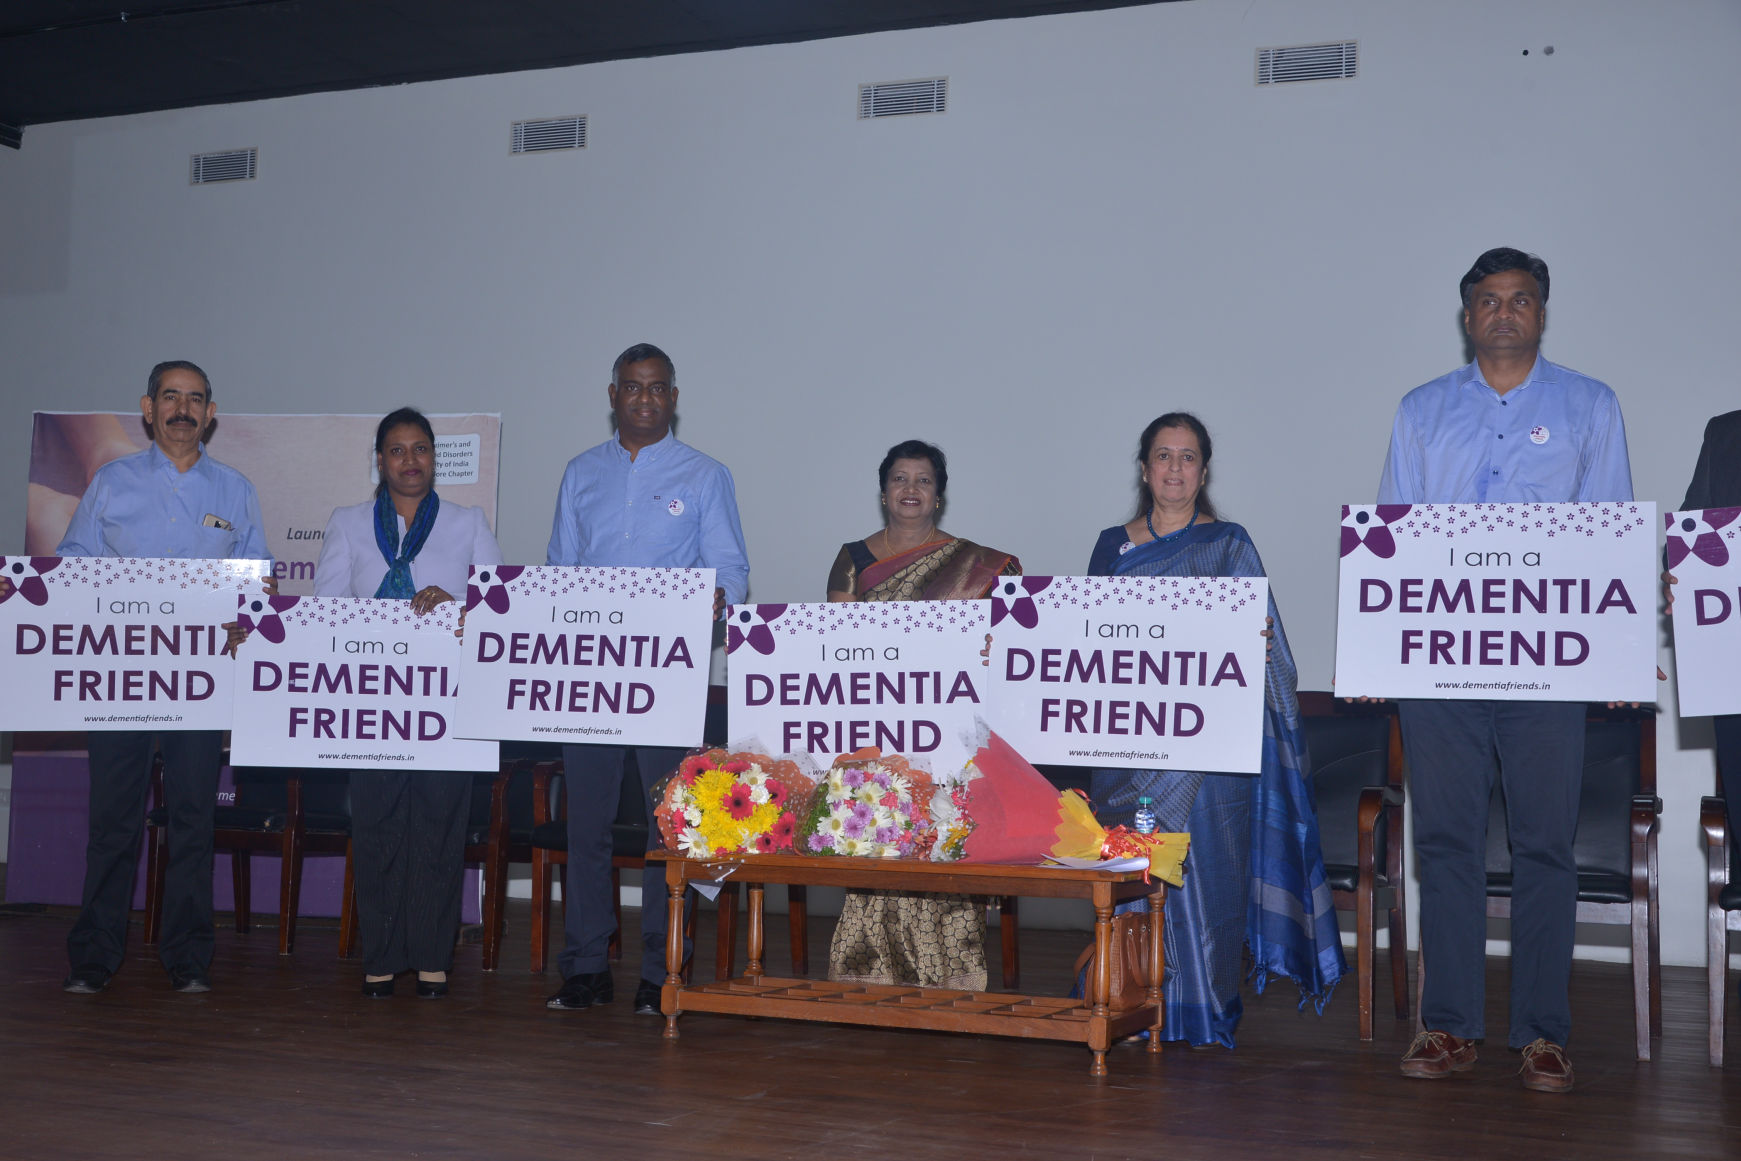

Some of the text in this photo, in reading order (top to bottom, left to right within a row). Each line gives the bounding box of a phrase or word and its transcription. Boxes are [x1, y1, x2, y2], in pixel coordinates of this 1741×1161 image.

[448, 470, 473, 478] Chapter
[1449, 547, 1541, 567] I am a
[96, 597, 175, 615] I am a
[1359, 578, 1638, 615] DEMENTIA
[551, 605, 624, 625] I am a
[1085, 619, 1165, 639] I am a
[332, 636, 409, 655] I am a
[476, 631, 695, 669] DEMENTIA
[821, 643, 899, 662] I am a
[1400, 629, 1590, 667] FRIEND
[1005, 647, 1248, 688] DEMENTIA
[54, 670, 216, 702] FRIEND
[252, 660, 459, 698] DEMENTI
[745, 670, 981, 707] DEMENTIA
[1434, 680, 1551, 692] www.dementiafriends.in
[506, 678, 656, 715] FRIEND
[84, 714, 183, 724] www.dementiafriends.in
[288, 707, 447, 742] FRIEND
[1040, 698, 1206, 738] FRIEND
[532, 725, 622, 737] www.dementiafriends.in
[783, 719, 942, 755] FRIEND
[318, 752, 415, 762] www.dementiafriends.in
[1068, 748, 1169, 761] www.dementiafriends.in
